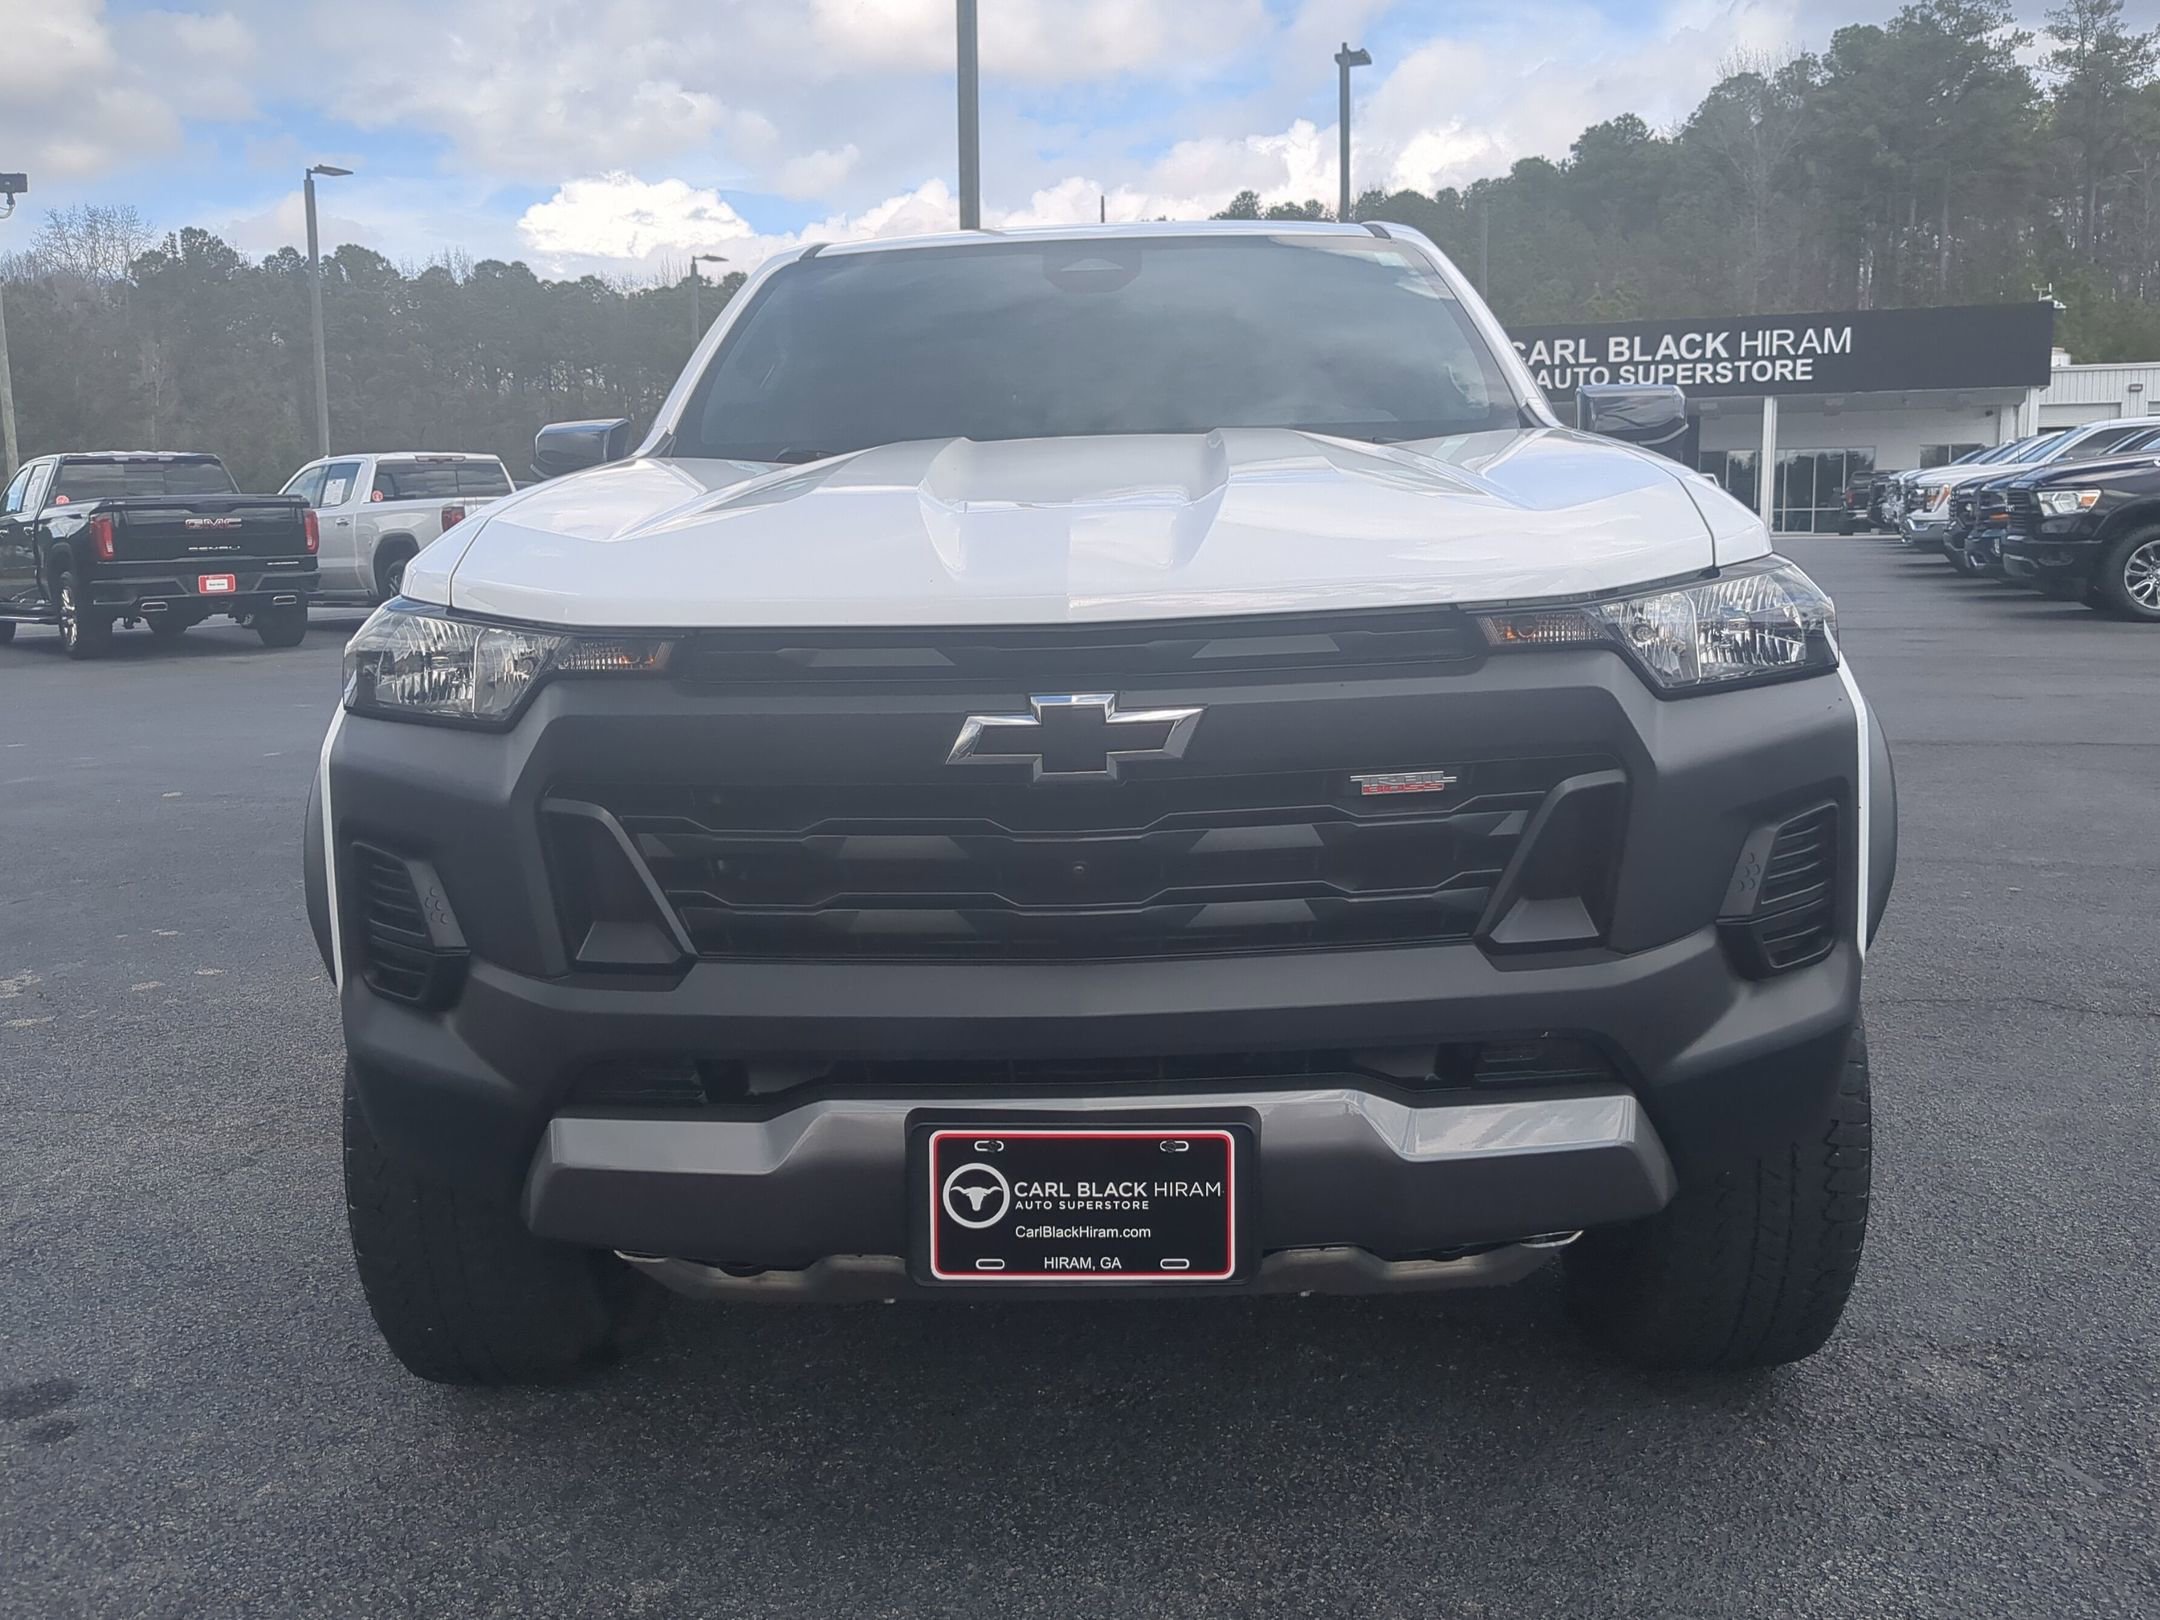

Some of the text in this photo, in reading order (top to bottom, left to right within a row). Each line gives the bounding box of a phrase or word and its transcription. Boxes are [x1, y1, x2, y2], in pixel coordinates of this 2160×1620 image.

[1608, 332, 1730, 363] BLACK
[1740, 326, 1852, 358] HIRAM
[1536, 358, 1813, 390] AUTO SUPERSTORE
[185, 517, 242, 529] GMC
[1014, 1181, 1221, 1198] CARL BLACK HIRAM
[1015, 1200, 1150, 1210] AUTO SUPERSTORE
[1015, 1225, 1151, 1239] CarlBlackHiram.com
[1043, 1256, 1122, 1270] HIRAM, GA
